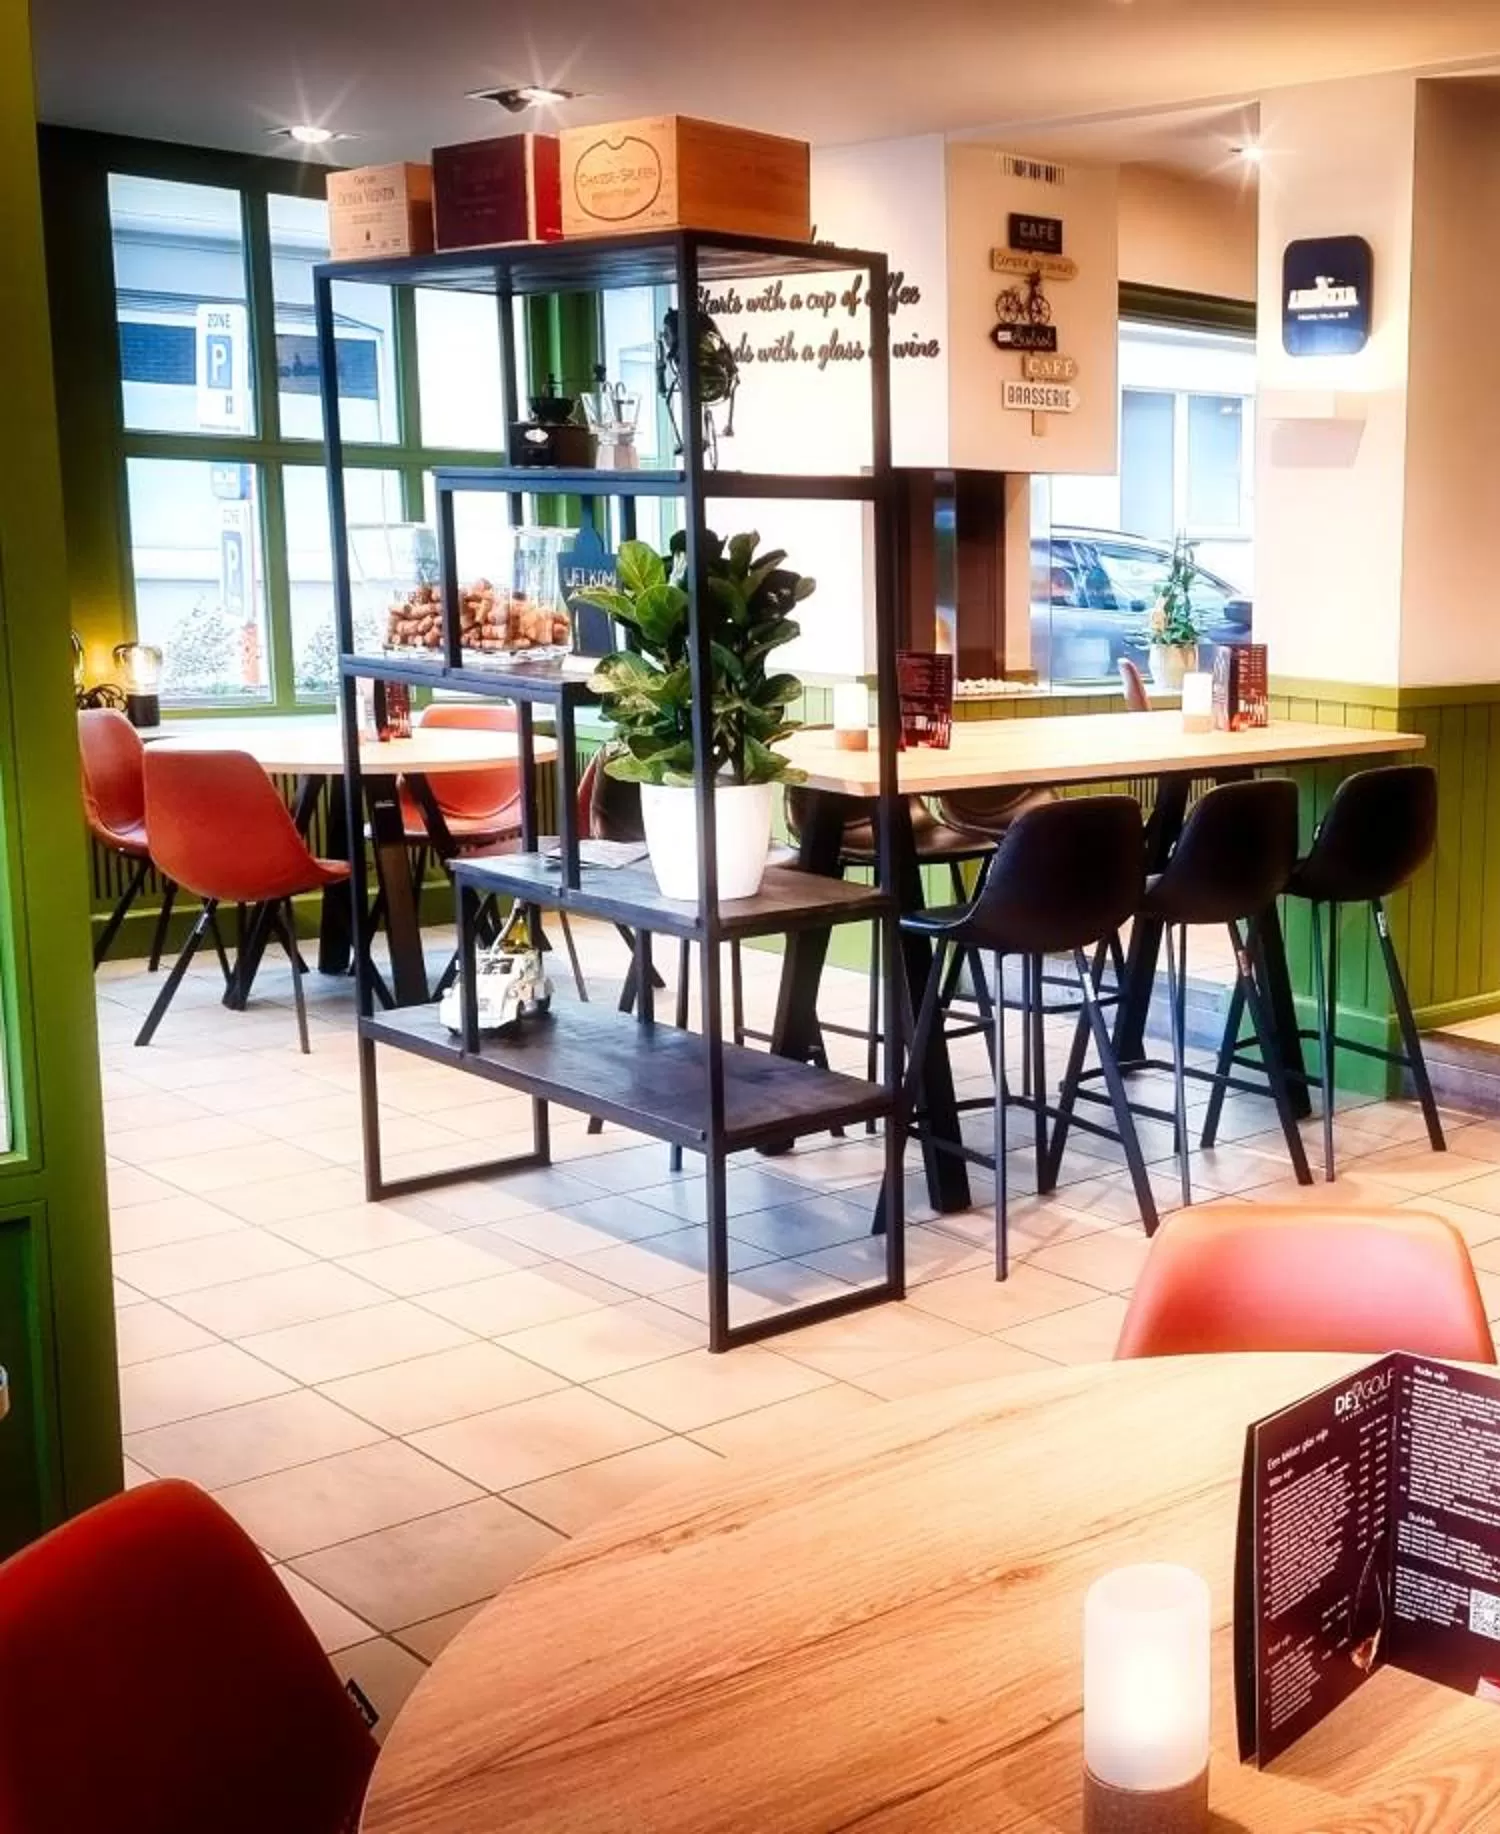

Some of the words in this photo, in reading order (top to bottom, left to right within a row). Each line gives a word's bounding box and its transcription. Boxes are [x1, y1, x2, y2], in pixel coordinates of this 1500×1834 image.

[746, 279, 787, 313] with
[790, 291, 803, 310] a
[806, 290, 837, 318] cup
[841, 274, 863, 317] of
[207, 313, 231, 329] ZONE
[212, 343, 228, 381] P
[757, 330, 798, 362] with
[801, 344, 815, 362] a
[818, 327, 865, 371] glass
[892, 332, 940, 359] wine
[1007, 385, 1071, 408] BRASSERIE
